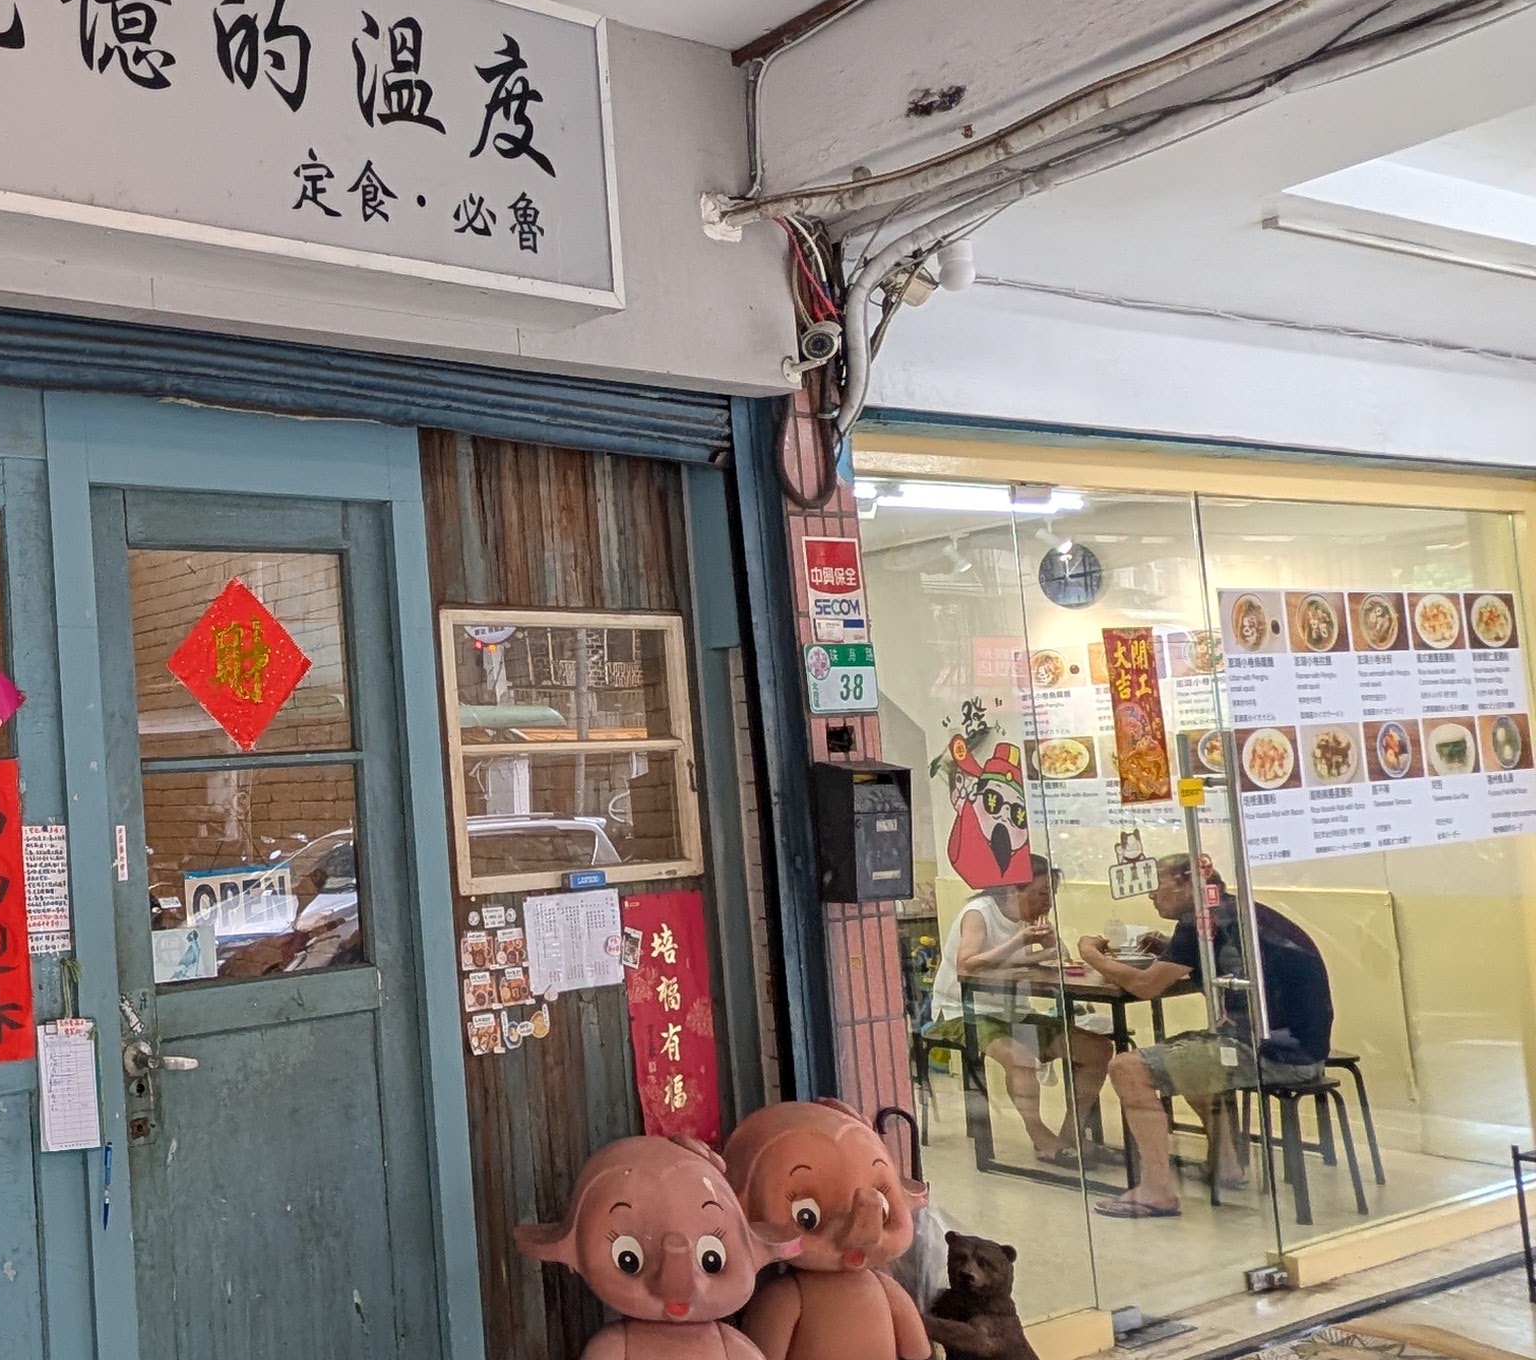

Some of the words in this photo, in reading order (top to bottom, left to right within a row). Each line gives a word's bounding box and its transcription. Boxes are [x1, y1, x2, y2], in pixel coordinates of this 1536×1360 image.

[810, 566, 857, 586] 中興保全
[814, 599, 861, 616] SECOM
[839, 673, 864, 702] 38
[192, 874, 293, 928] OPEN
[650, 922, 688, 1113] 培福有福
